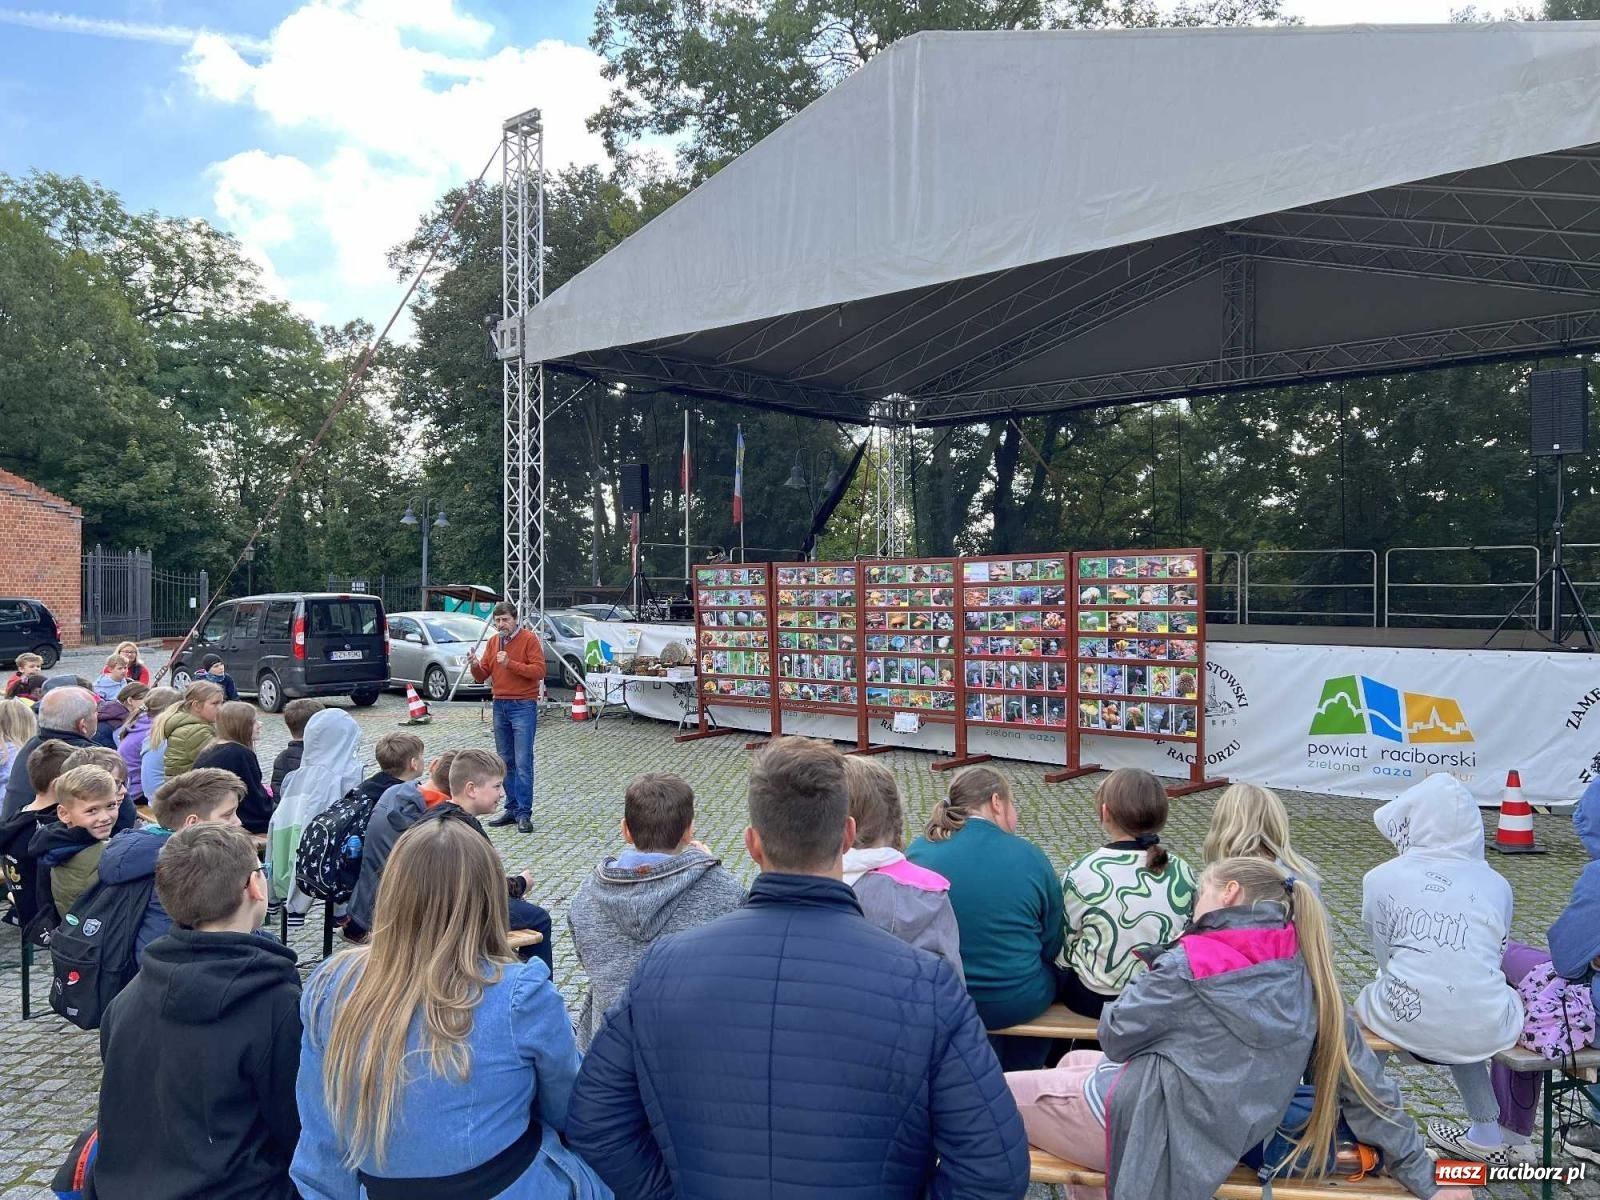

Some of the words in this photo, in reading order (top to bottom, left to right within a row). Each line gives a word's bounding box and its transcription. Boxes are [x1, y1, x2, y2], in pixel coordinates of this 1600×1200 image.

[1307, 742, 1368, 759] powiat
[1381, 747, 1476, 767] raciborski
[1307, 759, 1360, 773] zielona
[1372, 766, 1412, 777] oaza
